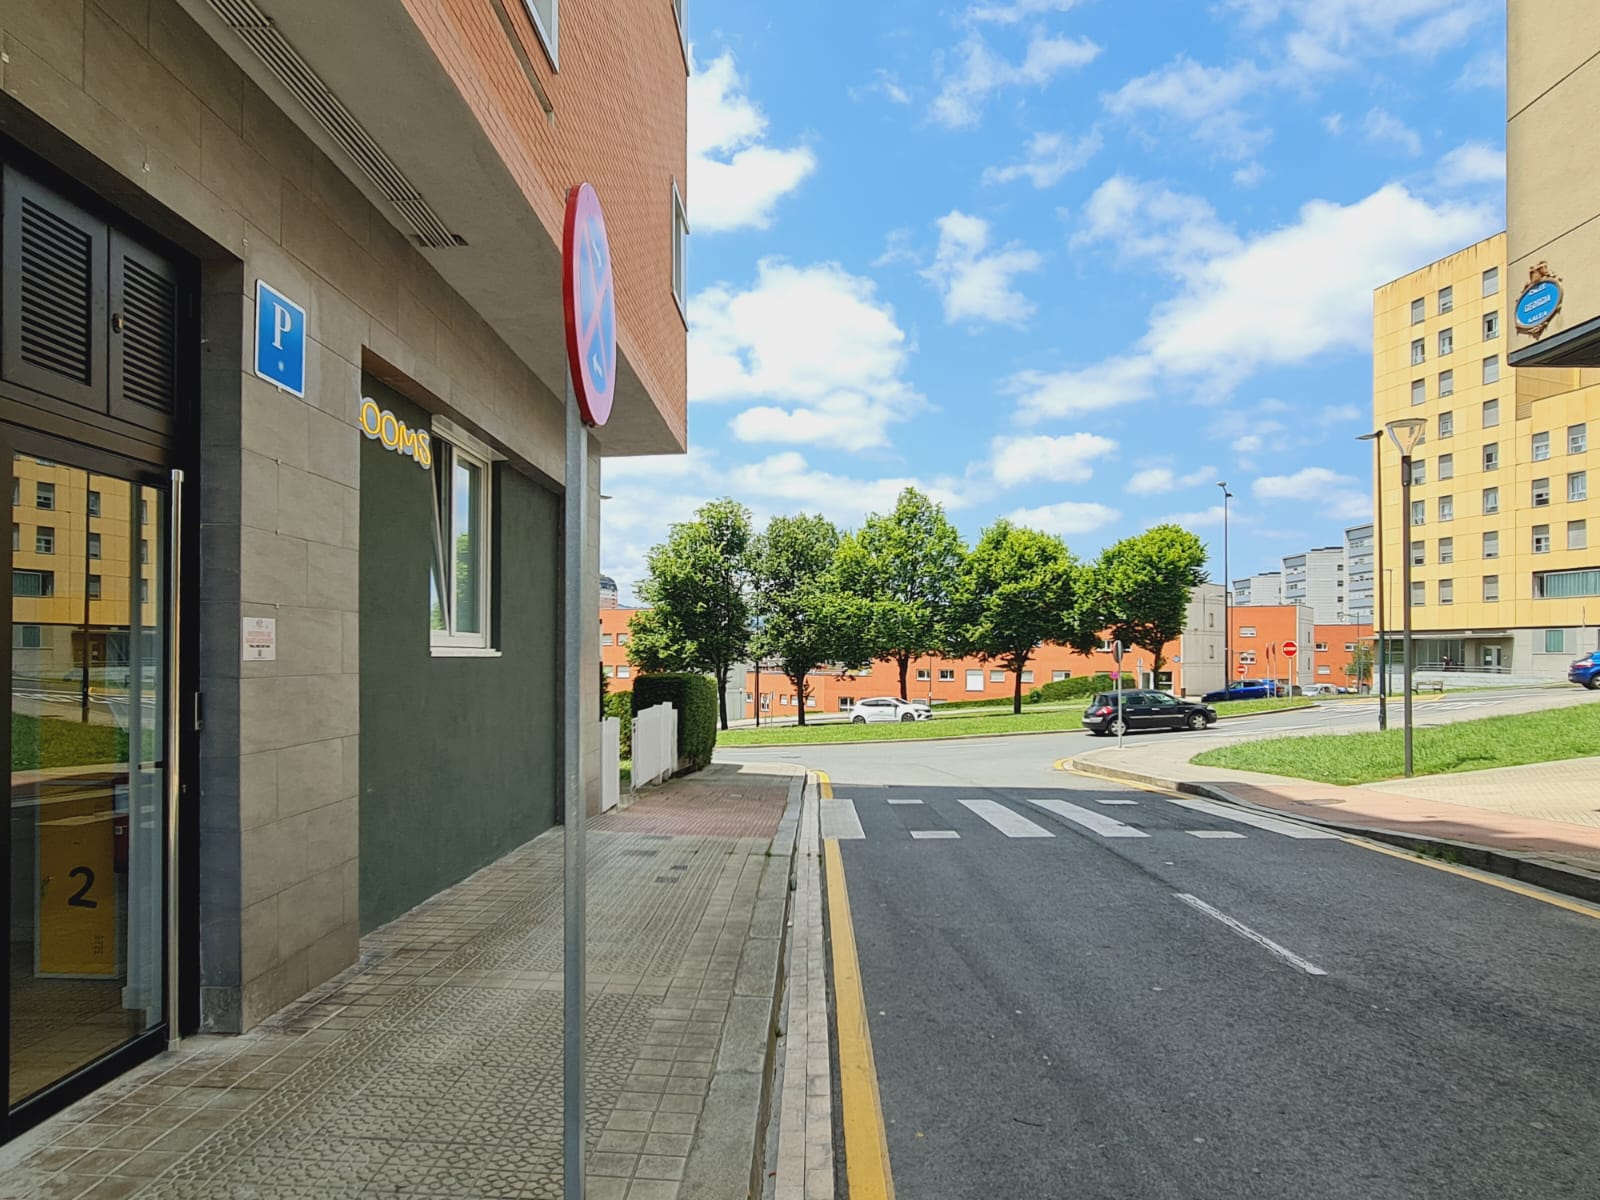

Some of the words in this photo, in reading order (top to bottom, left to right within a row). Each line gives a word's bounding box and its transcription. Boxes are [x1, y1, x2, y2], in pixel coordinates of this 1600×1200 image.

[272, 302, 291, 350] P
[359, 400, 431, 467] OOMS
[67, 866, 98, 908] 2
